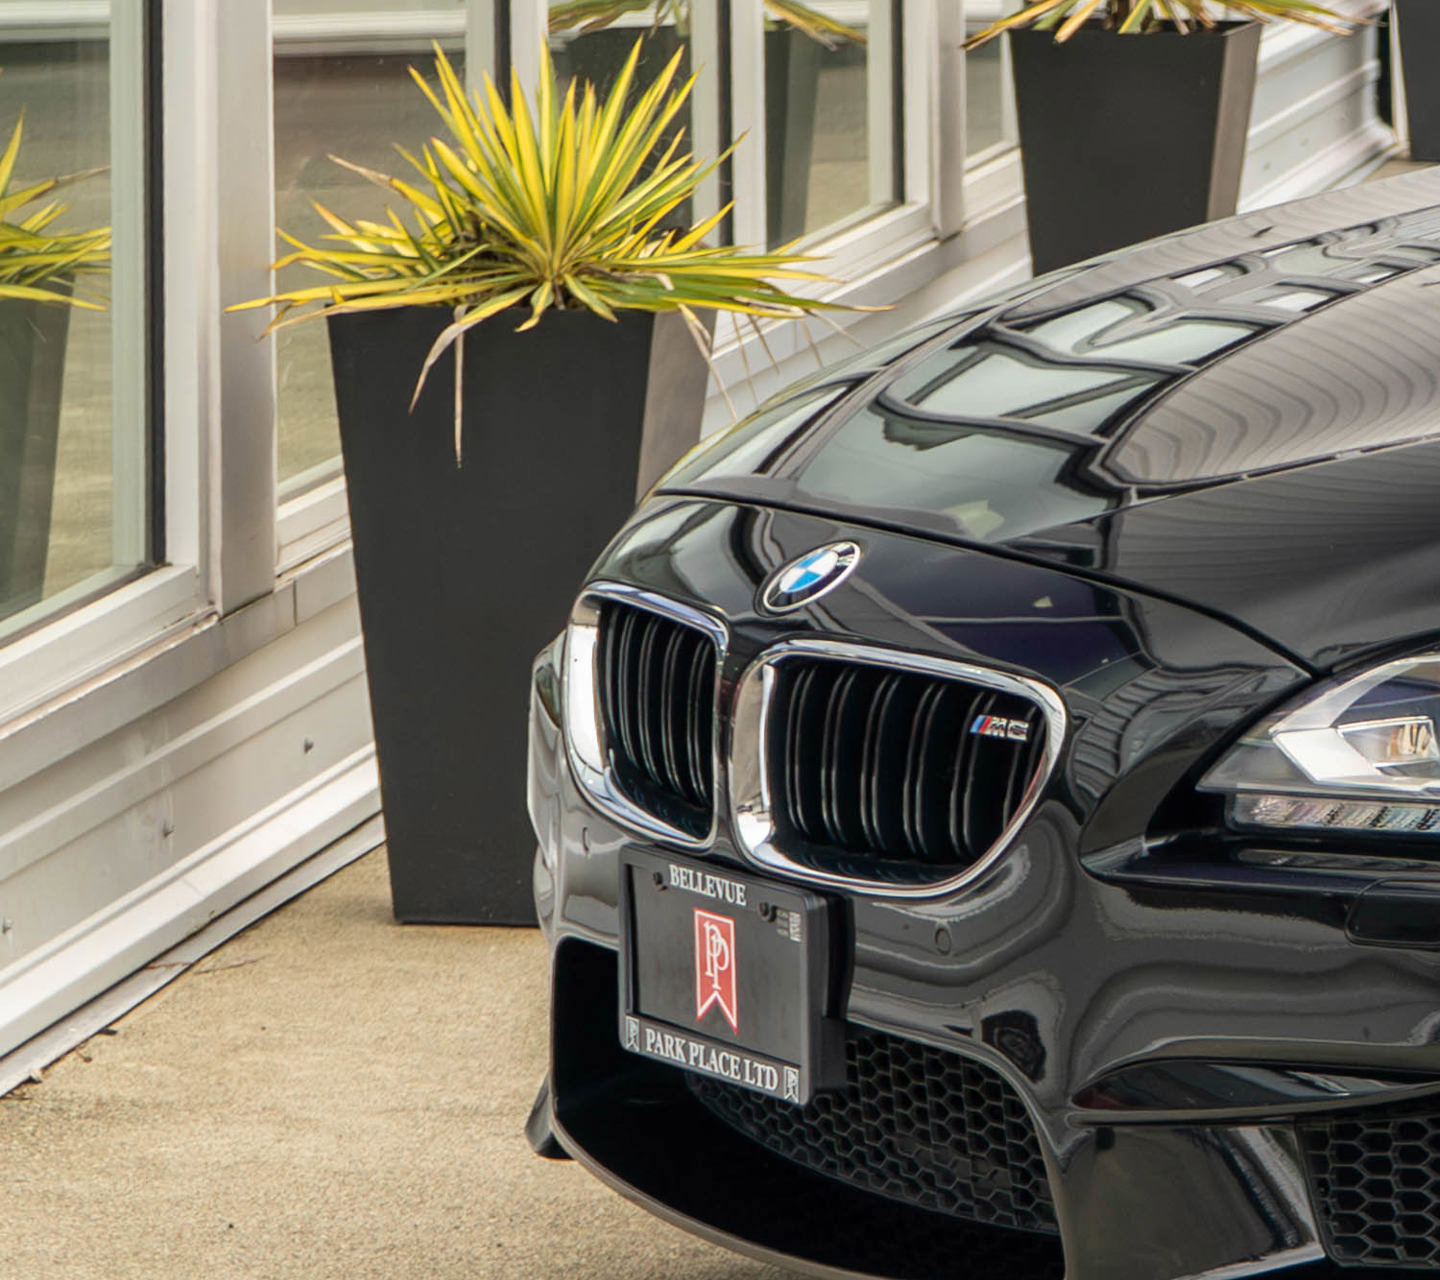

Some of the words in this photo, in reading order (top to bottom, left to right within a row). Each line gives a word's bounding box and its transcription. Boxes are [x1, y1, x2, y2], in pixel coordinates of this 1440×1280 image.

[983, 716, 1029, 741] M6
[668, 864, 746, 906] BELLEVUE
[645, 1027, 689, 1064] PARK
[689, 1041, 741, 1081] PLACE
[743, 1058, 778, 1091] LTD
